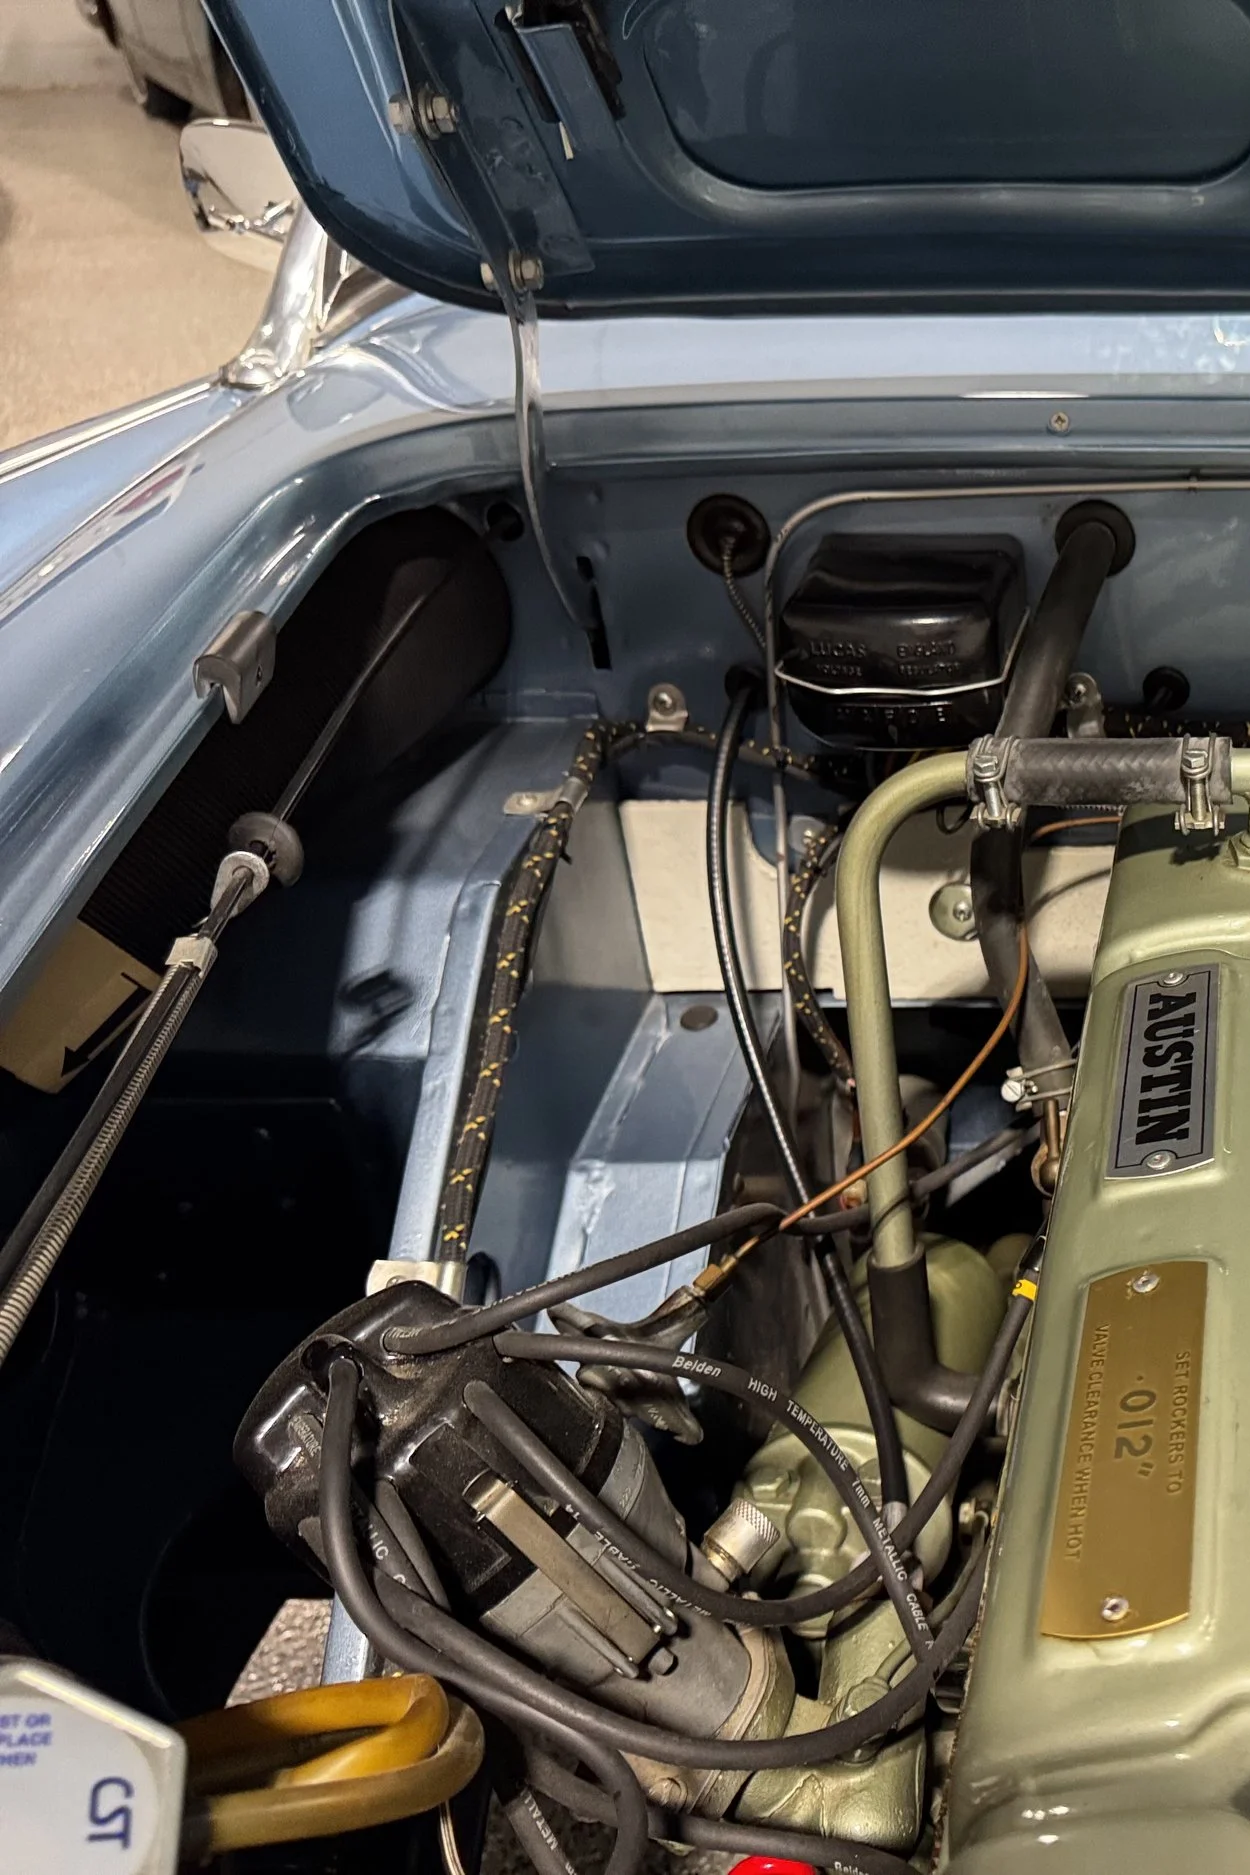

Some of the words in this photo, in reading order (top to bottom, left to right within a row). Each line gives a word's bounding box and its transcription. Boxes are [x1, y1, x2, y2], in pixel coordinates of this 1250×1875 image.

[809, 640, 868, 659] LUCAS
[1135, 991, 1197, 1146] AUSTIN
[1091, 1323, 1110, 1369] VALVE
[1174, 1350, 1191, 1380] SET
[1078, 1371, 1104, 1464] CLEARANCE
[1168, 1384, 1188, 1465] ROCKERS
[672, 1355, 722, 1378] Belden
[748, 1377, 778, 1402] HIGH
[786, 1399, 849, 1472] TEMPERATURE
[872, 1516, 908, 1582] METALLIC
[905, 1592, 930, 1632] CABLE
[1069, 1467, 1092, 1519] WHEN
[1166, 1470, 1184, 1494] TO
[1064, 1523, 1083, 1559] HOT
